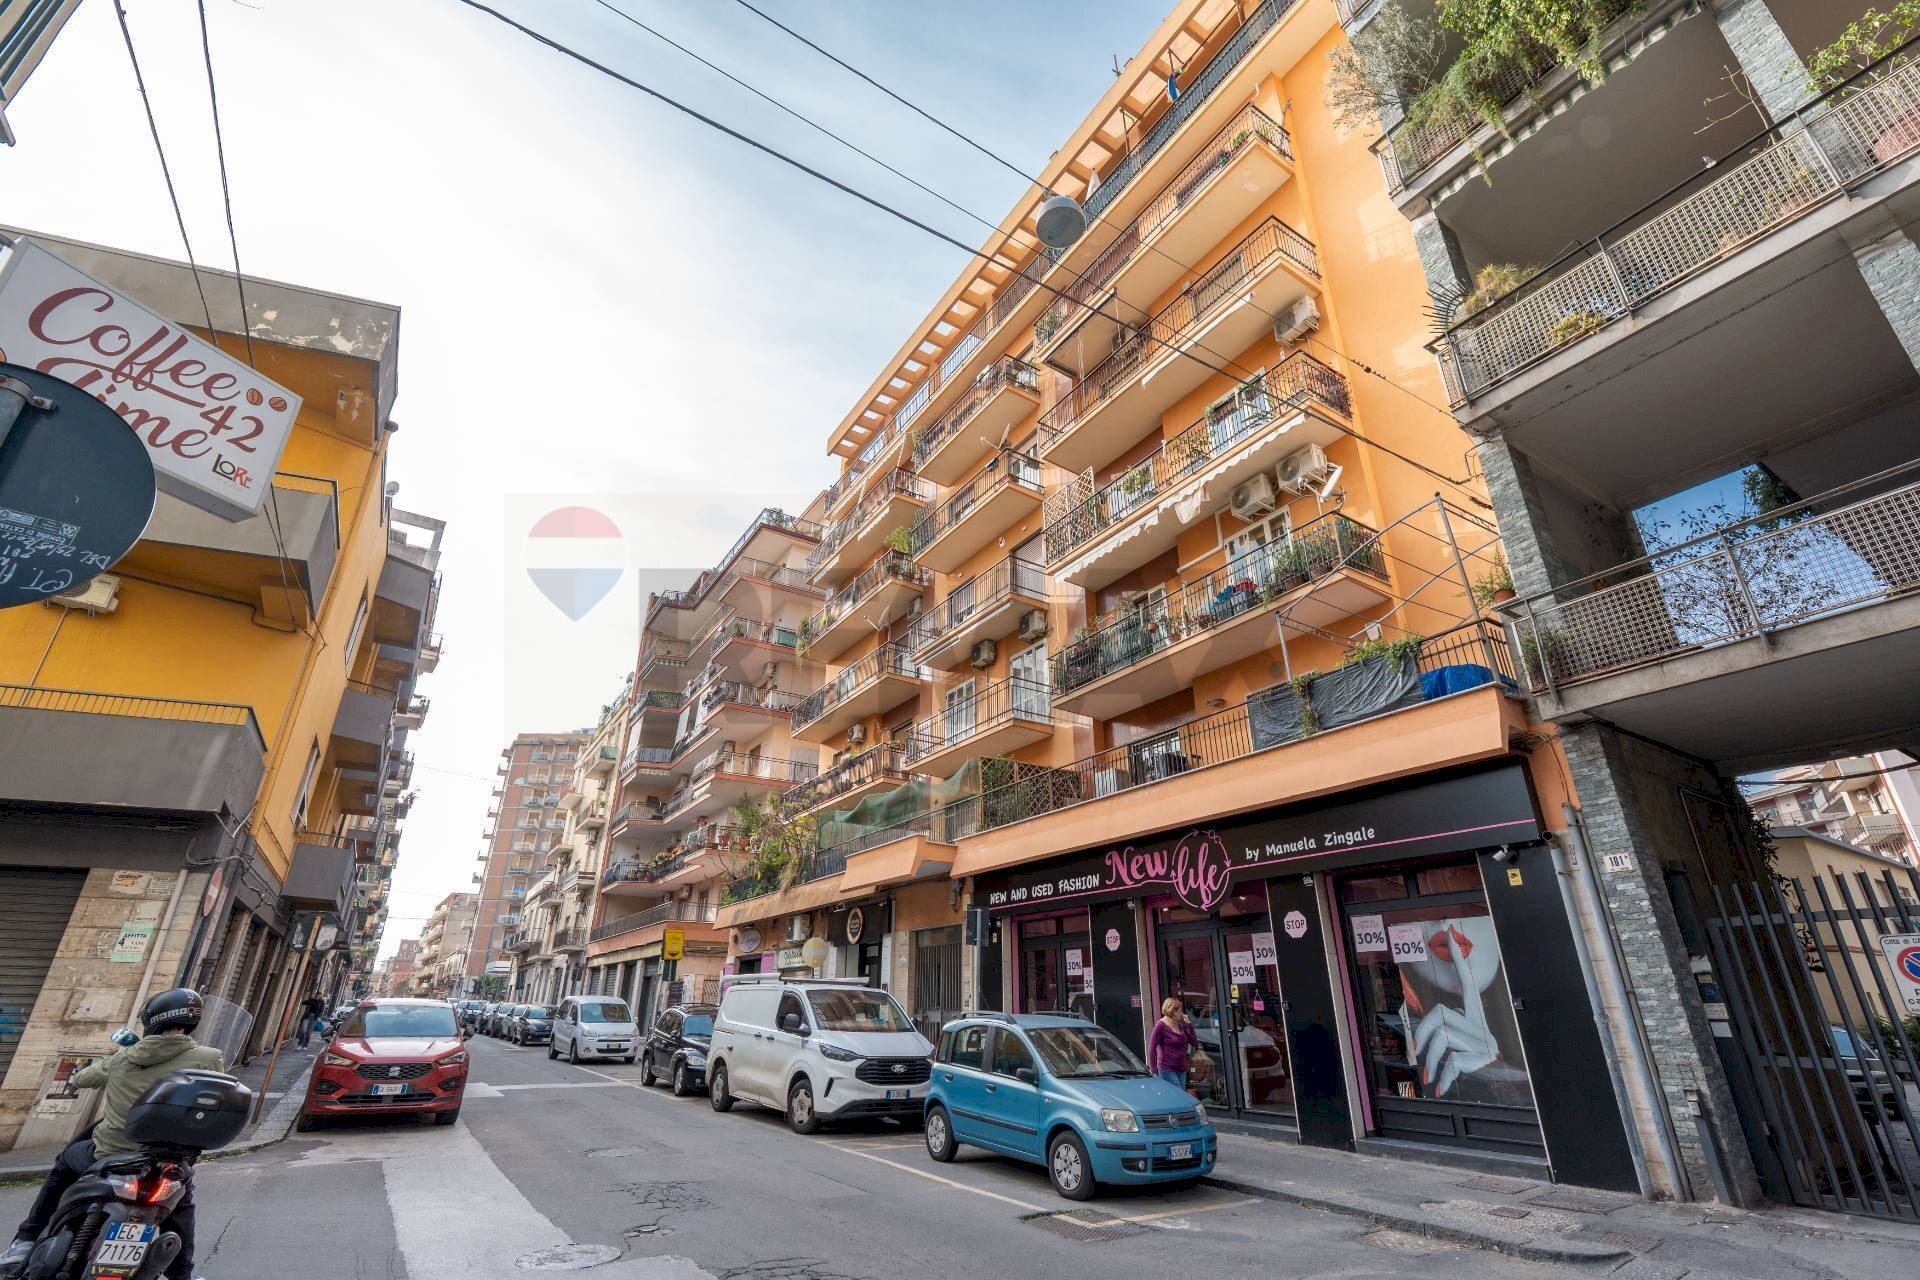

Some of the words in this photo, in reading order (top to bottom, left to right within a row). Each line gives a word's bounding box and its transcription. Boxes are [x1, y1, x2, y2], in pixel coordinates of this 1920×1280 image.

[28, 287, 240, 400] Coffee
[200, 404, 265, 453] 42
[1245, 847, 1260, 862] by
[1265, 836, 1317, 857] Manuela
[1324, 827, 1376, 846] Zingale
[1105, 846, 1168, 885] New
[990, 891, 1007, 905] NEW
[1010, 888, 1027, 901] AND
[1031, 883, 1053, 897] USED
[1058, 874, 1100, 893] FASHION
[1286, 920, 1305, 930] STOP
[1106, 935, 1119, 945] STOP
[1357, 931, 1385, 945] 30%
[1393, 941, 1424, 955] 50%
[1068, 960, 1082, 970] 30%
[1232, 966, 1254, 977] 50%
[98, 1244, 144, 1262] 71176
